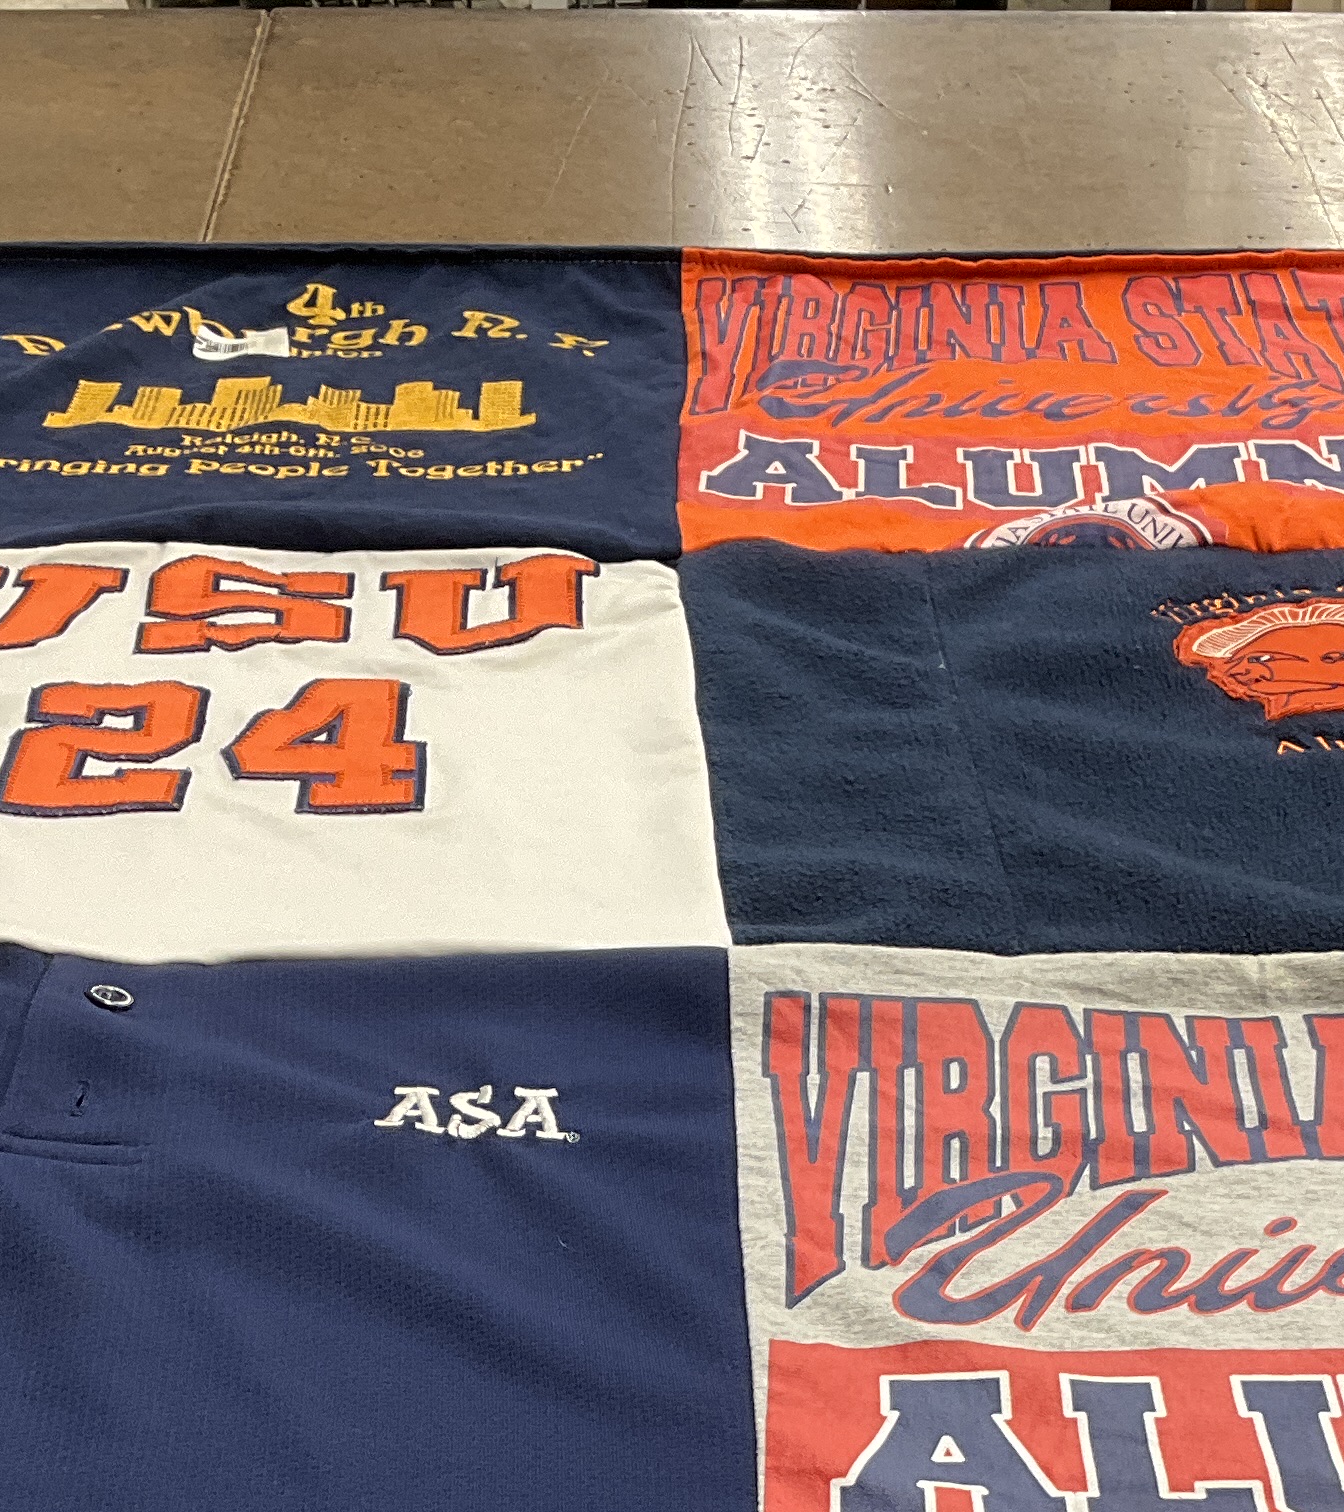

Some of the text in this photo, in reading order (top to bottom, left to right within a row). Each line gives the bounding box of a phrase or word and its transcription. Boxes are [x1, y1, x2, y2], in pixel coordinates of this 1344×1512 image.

[286, 282, 385, 327] 4th
[689, 273, 1118, 415] VIRGINIA
[183, 458, 351, 480] People
